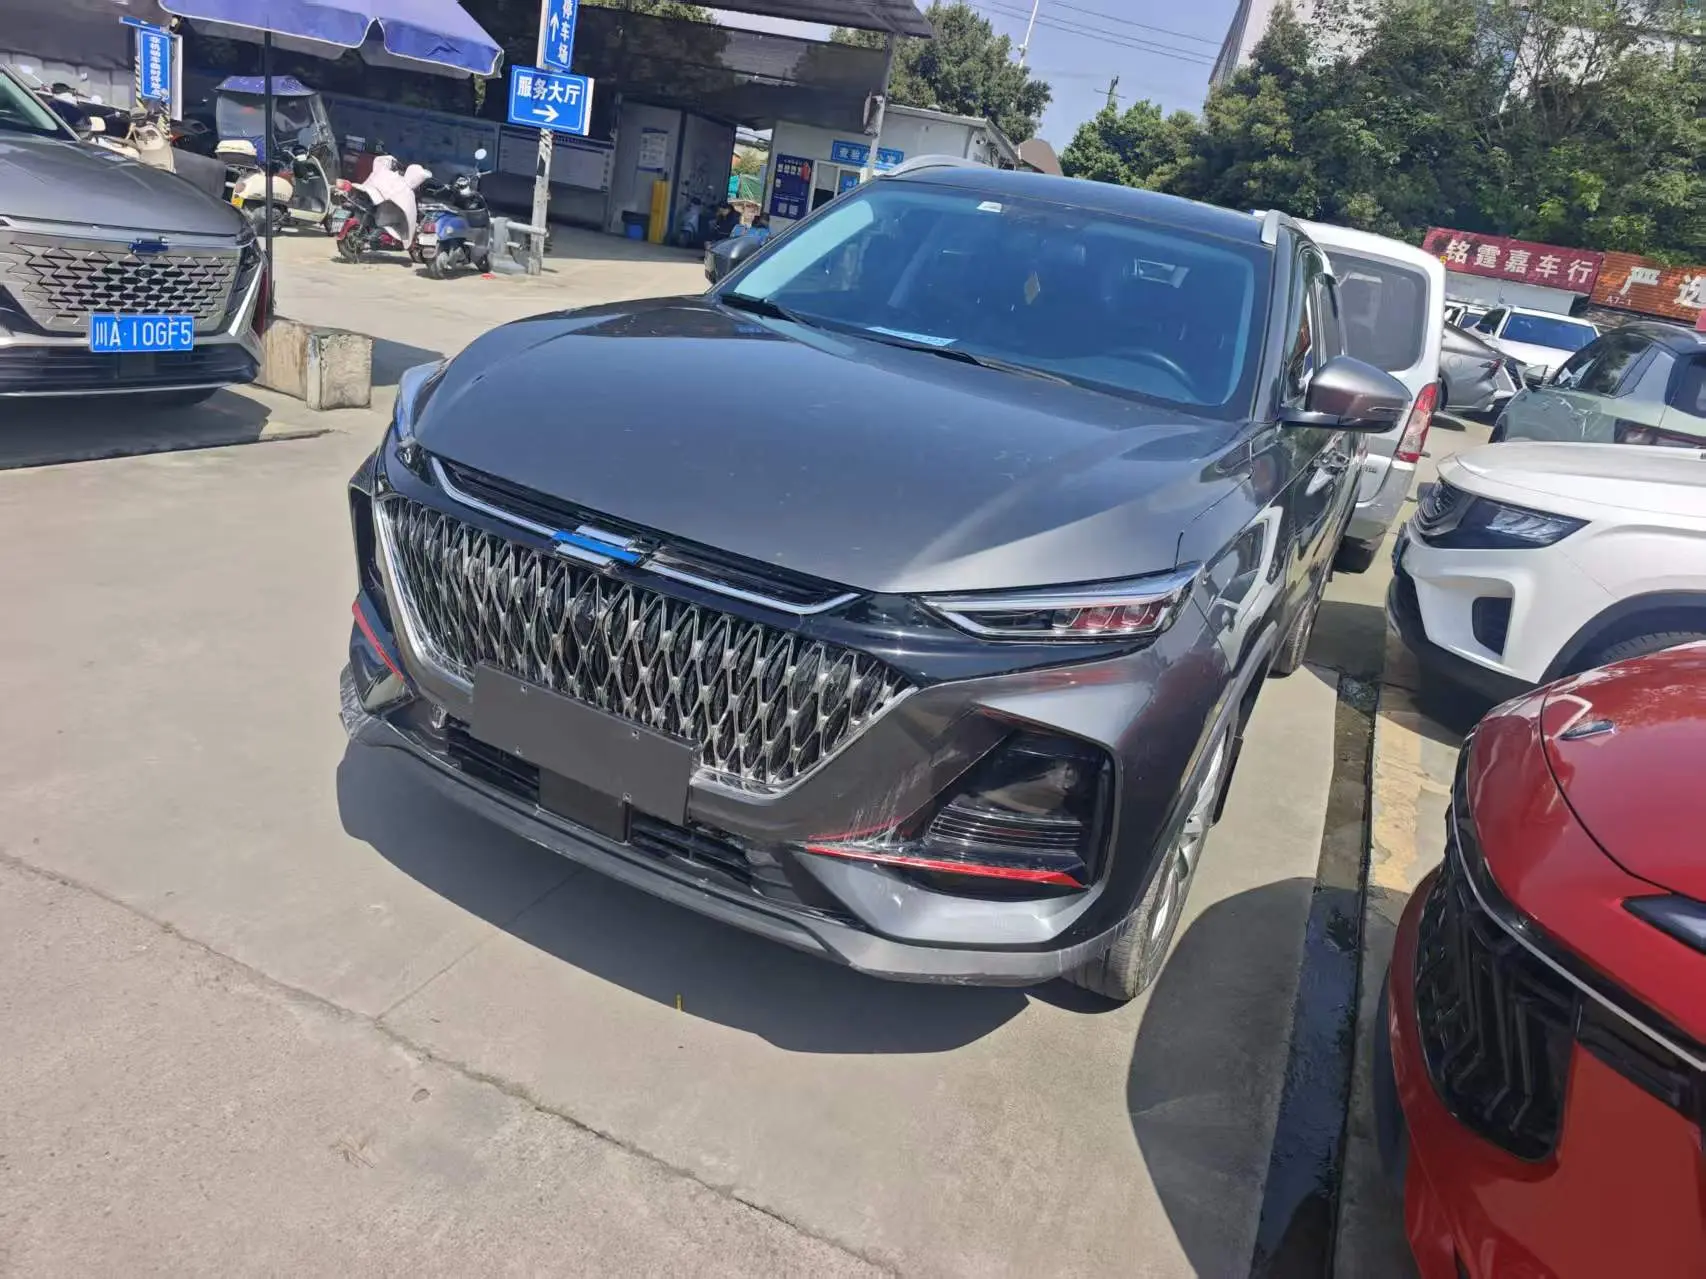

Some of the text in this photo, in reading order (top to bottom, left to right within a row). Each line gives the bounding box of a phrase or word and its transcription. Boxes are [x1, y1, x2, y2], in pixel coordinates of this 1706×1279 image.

[517, 75, 581, 105] 服务大厅
[1446, 239, 1594, 284] 铭霆嘉车行
